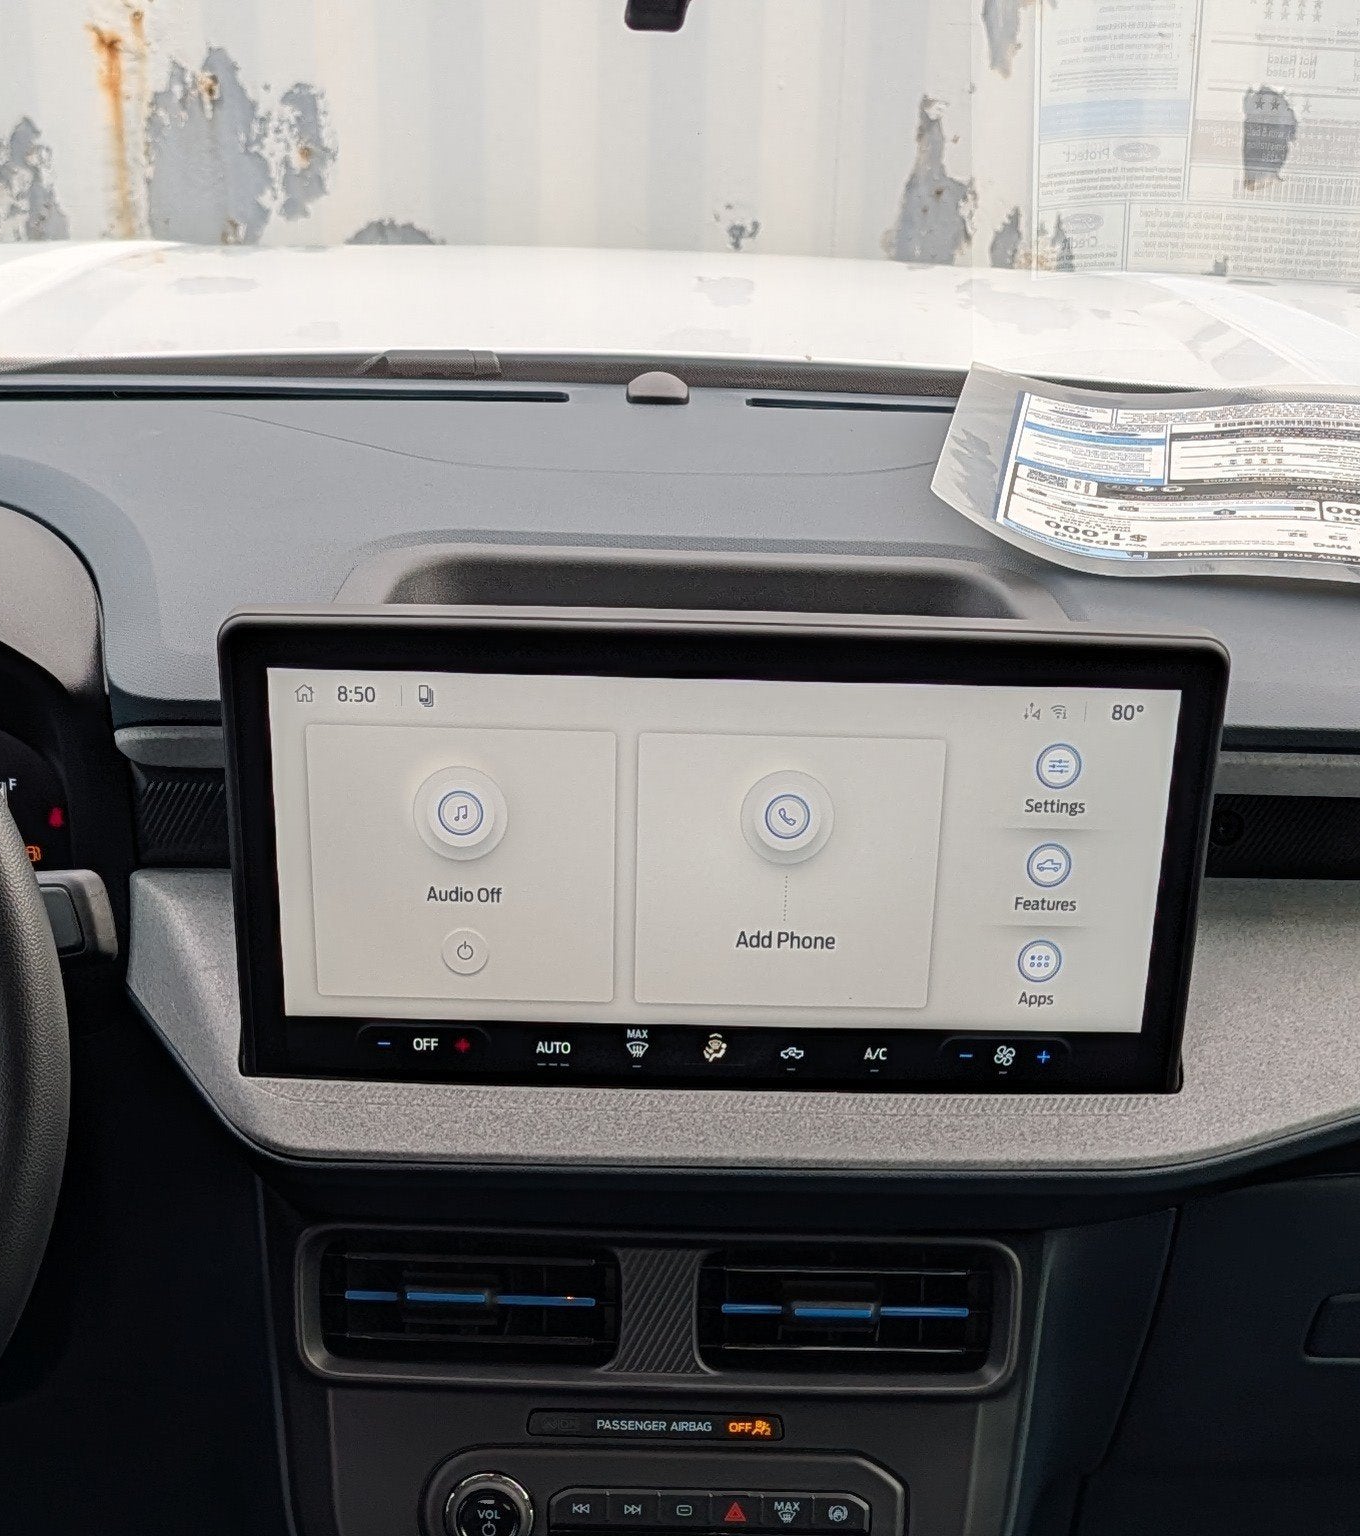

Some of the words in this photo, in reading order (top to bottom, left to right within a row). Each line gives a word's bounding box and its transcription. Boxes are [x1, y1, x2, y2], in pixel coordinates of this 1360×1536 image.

[1044, 520, 1148, 543] $1,000
[1313, 542, 1352, 551] MPG
[337, 686, 376, 704] 8:50
[1111, 703, 1145, 722] 80°
[8, 778, 18, 791] F
[1024, 798, 1086, 818] Settings
[426, 886, 474, 904] Audio
[477, 886, 503, 904] Off
[1014, 896, 1077, 913] Features
[736, 931, 772, 950] Add
[777, 931, 836, 951] Phone
[1018, 991, 1054, 1008] Apps
[626, 1029, 649, 1040] MAX
[413, 1038, 439, 1052] OFF
[536, 1040, 571, 1056] AUTO
[863, 1047, 887, 1062] A/C
[596, 1418, 667, 1434] PASSENGER
[670, 1419, 713, 1434] AIRBAG
[728, 1419, 752, 1434] OFF
[476, 1509, 501, 1520] VOL
[773, 1501, 800, 1512] MAX
